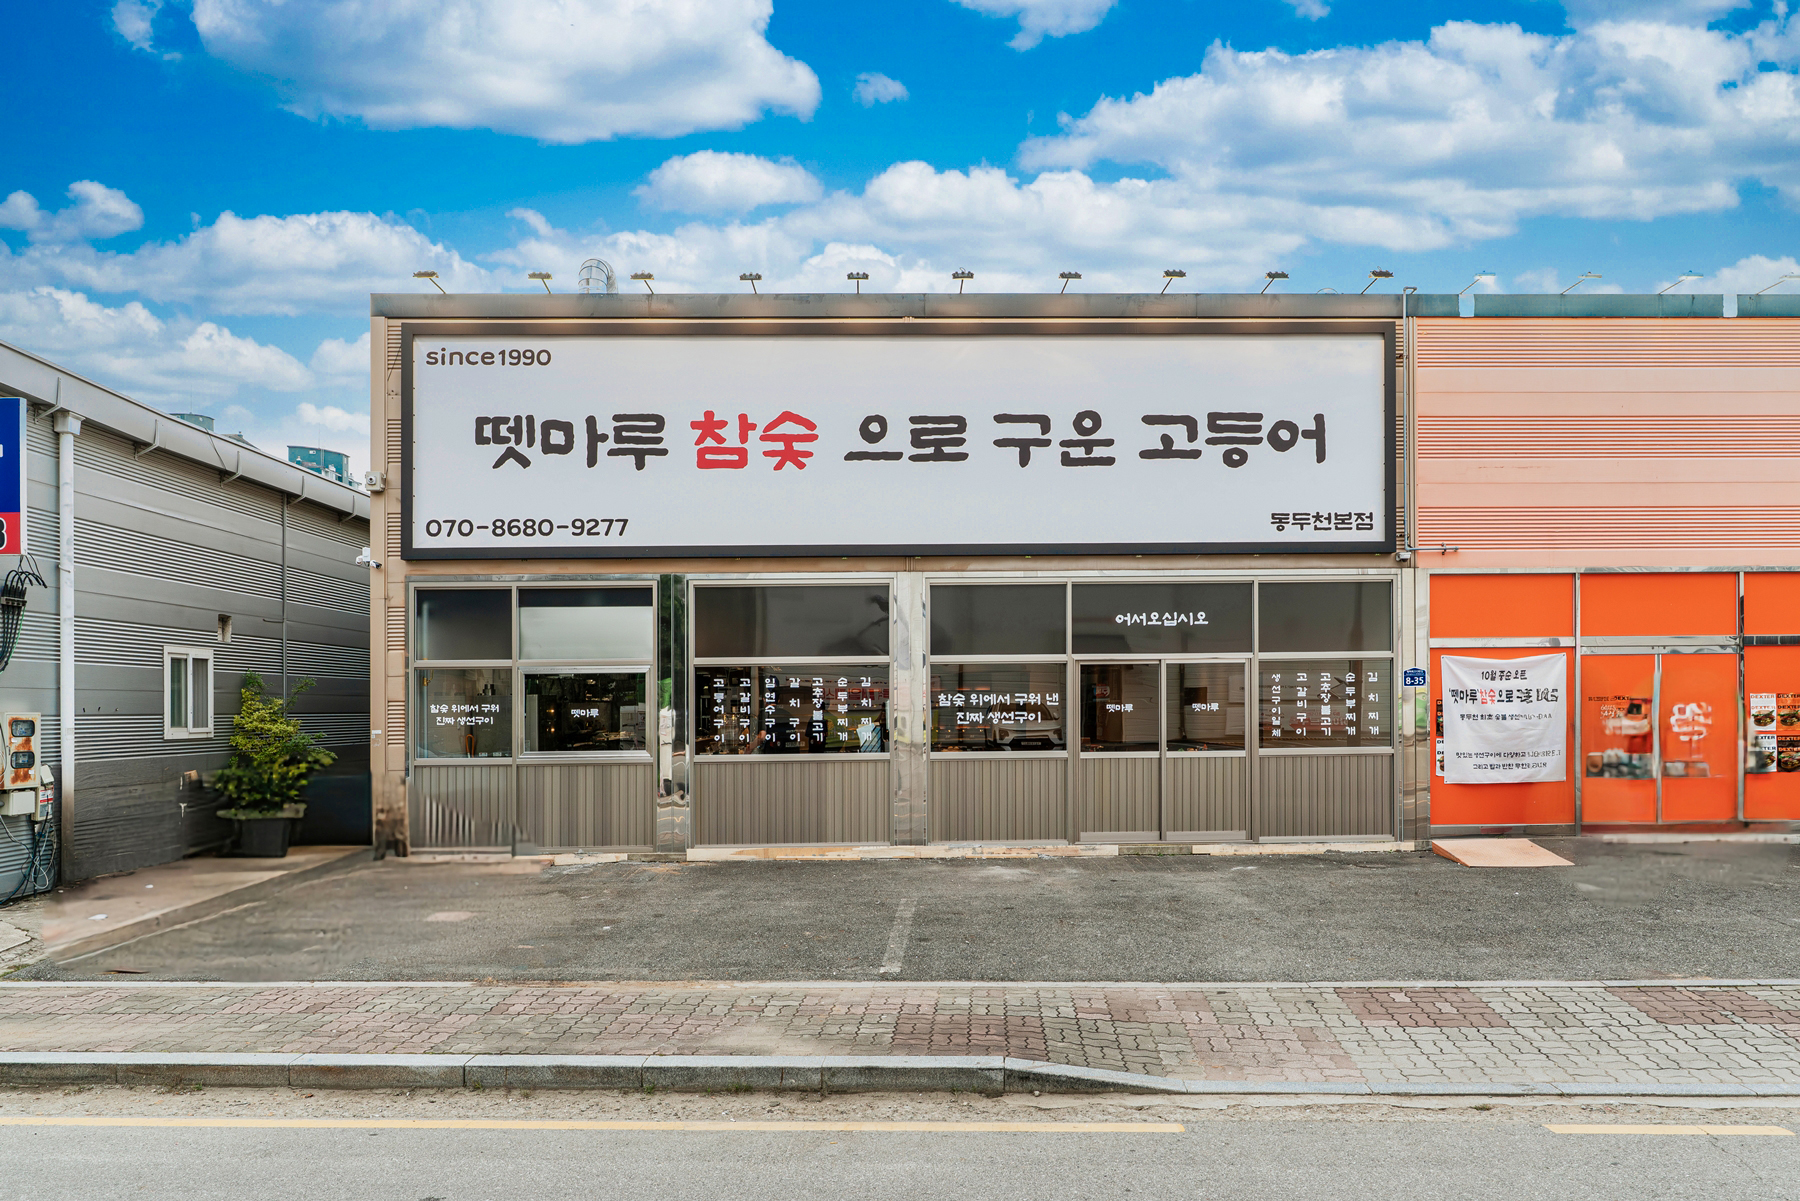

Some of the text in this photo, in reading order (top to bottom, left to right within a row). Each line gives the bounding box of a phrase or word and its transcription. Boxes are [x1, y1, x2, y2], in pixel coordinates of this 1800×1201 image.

[426, 348, 552, 367] since1990
[474, 409, 1328, 471] 뗏마루 참숯 으로 구운 고등어
[425, 518, 629, 538] 070-8680-9277
[1270, 511, 1375, 532] 동두천본점
[1115, 611, 1209, 627] 어서오십시오
[1405, 676, 1425, 685] 8-35
[1481, 669, 1497, 682] 10월
[451, 703, 479, 713] 위에서
[481, 703, 500, 713] 구워
[765, 677, 776, 742] 임연수구이
[789, 677, 801, 742] 갈치구이
[837, 677, 848, 742] 순두부찌개
[860, 676, 872, 741] 김치찌개
[938, 692, 1059, 707] 참숯 위에서 구워 낸
[1106, 703, 1134, 713] 뗏마루
[1191, 702, 1220, 712] 뗏마루
[1271, 673, 1281, 738] 생선구이일체
[1295, 672, 1307, 736] 고갈비구이
[1345, 672, 1356, 736] 순두부찌개
[1367, 671, 1379, 735] 김치찌개
[570, 708, 600, 718] 뗏마루
[739, 678, 751, 743] 고갈비구이
[956, 711, 1042, 725] 진짜 생선구이
[436, 716, 494, 726] 진짜 생선구이
